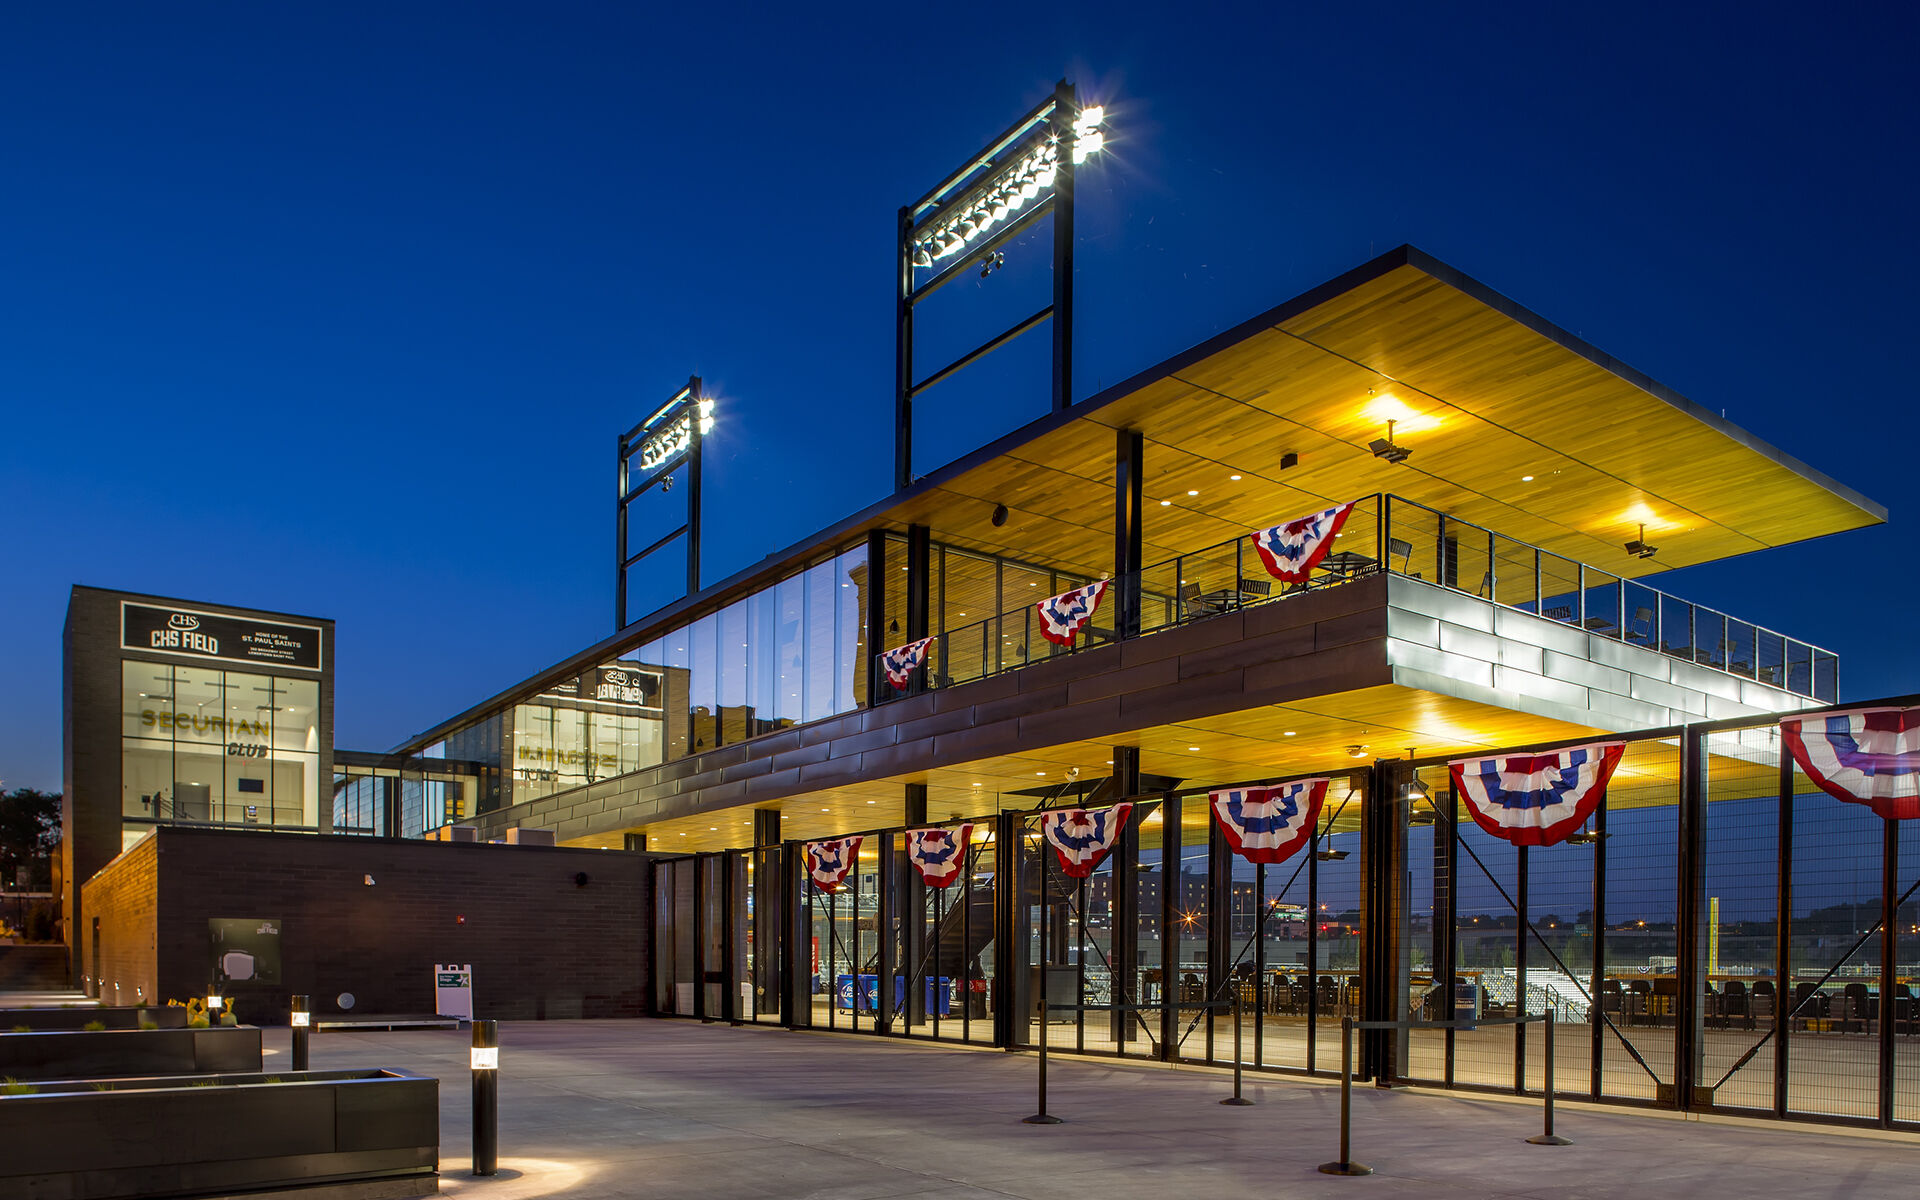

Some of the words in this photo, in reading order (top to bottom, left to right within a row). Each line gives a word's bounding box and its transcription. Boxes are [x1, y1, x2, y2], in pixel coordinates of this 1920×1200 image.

[170, 613, 197, 626] CHS
[151, 629, 180, 648] CHS
[182, 631, 219, 655] FIELD
[254, 637, 273, 645] PAUL
[274, 639, 302, 648] SAINTS
[142, 710, 269, 736] SECURIAN
[227, 742, 269, 758] CLUB
